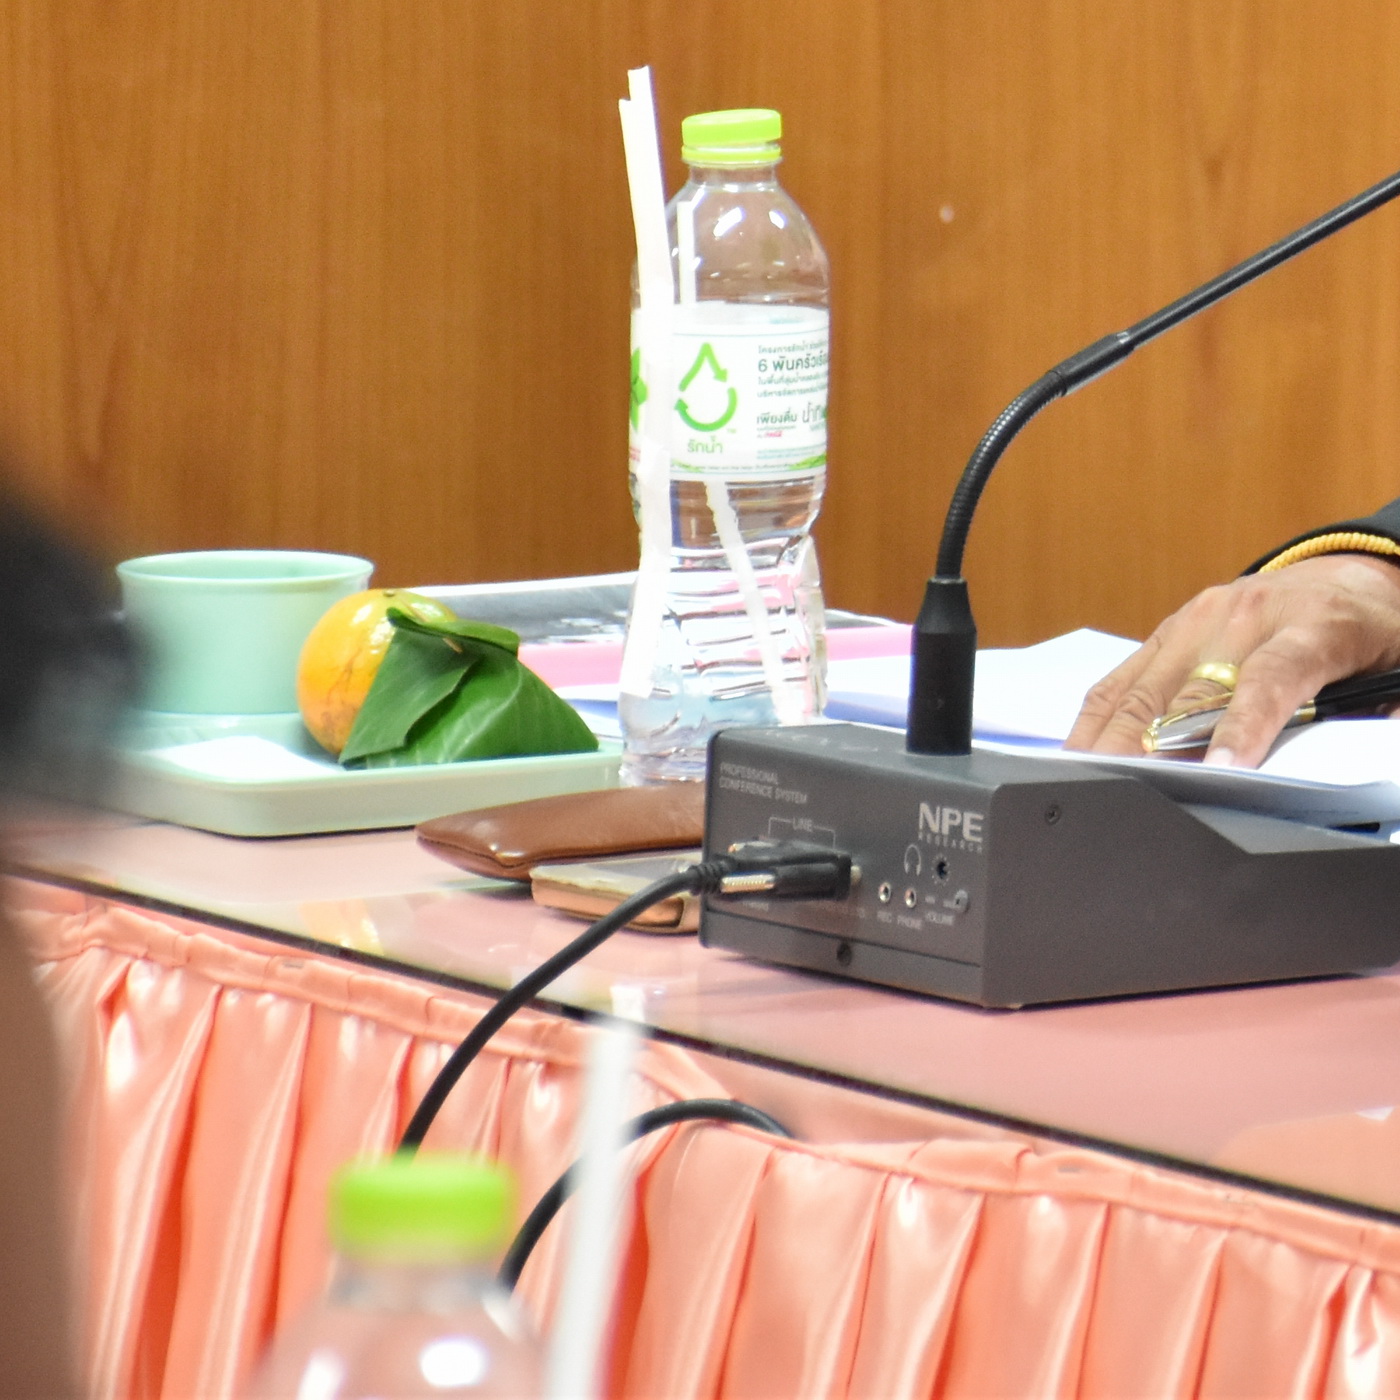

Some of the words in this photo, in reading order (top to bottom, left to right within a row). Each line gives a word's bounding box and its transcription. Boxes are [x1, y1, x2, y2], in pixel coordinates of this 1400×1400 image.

[758, 359, 768, 373] 6
[686, 435, 724, 454] รักน้ำ
[919, 802, 984, 842] NPE
